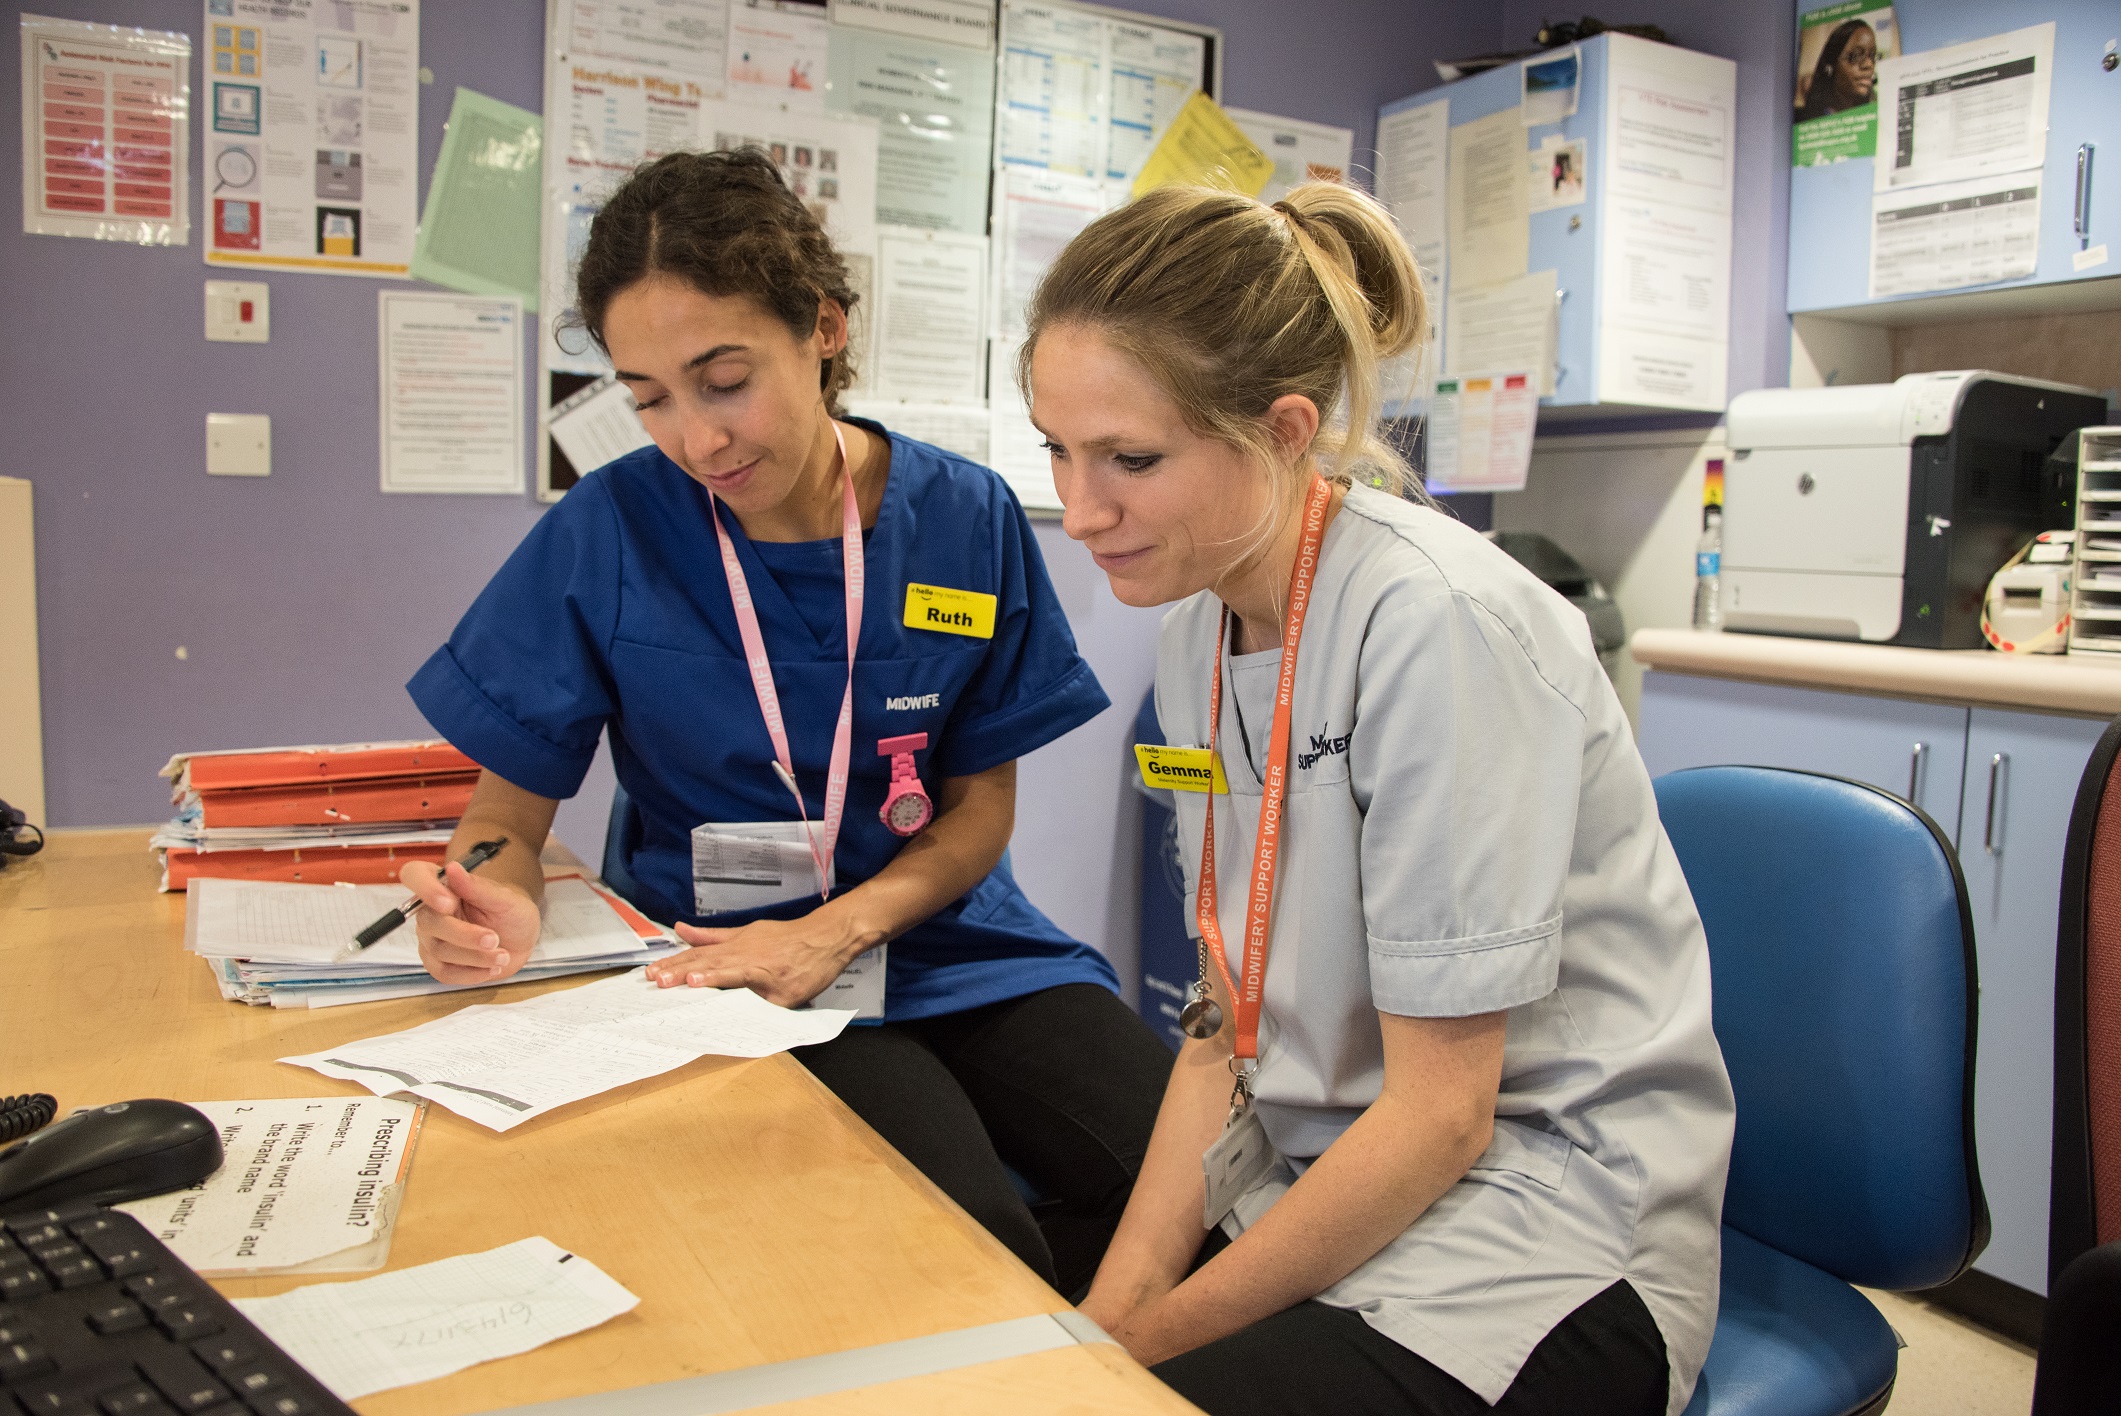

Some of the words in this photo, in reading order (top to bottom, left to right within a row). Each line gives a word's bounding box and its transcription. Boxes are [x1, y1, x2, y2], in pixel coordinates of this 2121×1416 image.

[848, 521, 865, 598] MIDWIFE
[1279, 616, 1300, 706] MIDWIFERY
[1293, 535, 1318, 611] SUPPORT
[1307, 479, 1329, 533] WORKER
[927, 607, 972, 627] Ruth
[752, 655, 782, 733] MIDWIFE
[886, 693, 940, 711] MIDWIFE
[1148, 761, 1214, 780] Gemma
[825, 773, 846, 849] MIDWIFE
[1263, 765, 1283, 835] WORKER
[1204, 808, 1213, 874] WORKER
[1254, 839, 1274, 912] SUPPORT
[1202, 879, 1218, 940] SUPPORT
[1246, 916, 1265, 1002] MIDWIFERY
[234, 1107, 254, 1115] 2.
[334, 1103, 361, 1139] Remember
[266, 1123, 288, 1138] the
[289, 1122, 316, 1145] Write
[252, 1139, 282, 1165] brand
[281, 1147, 303, 1163] the
[357, 1118, 401, 1176] Prescribing
[236, 1167, 262, 1194] name
[269, 1164, 292, 1188] word
[345, 1180, 384, 1228] insulin?
[160, 1229, 184, 1241] in
[236, 1235, 260, 1257] and
